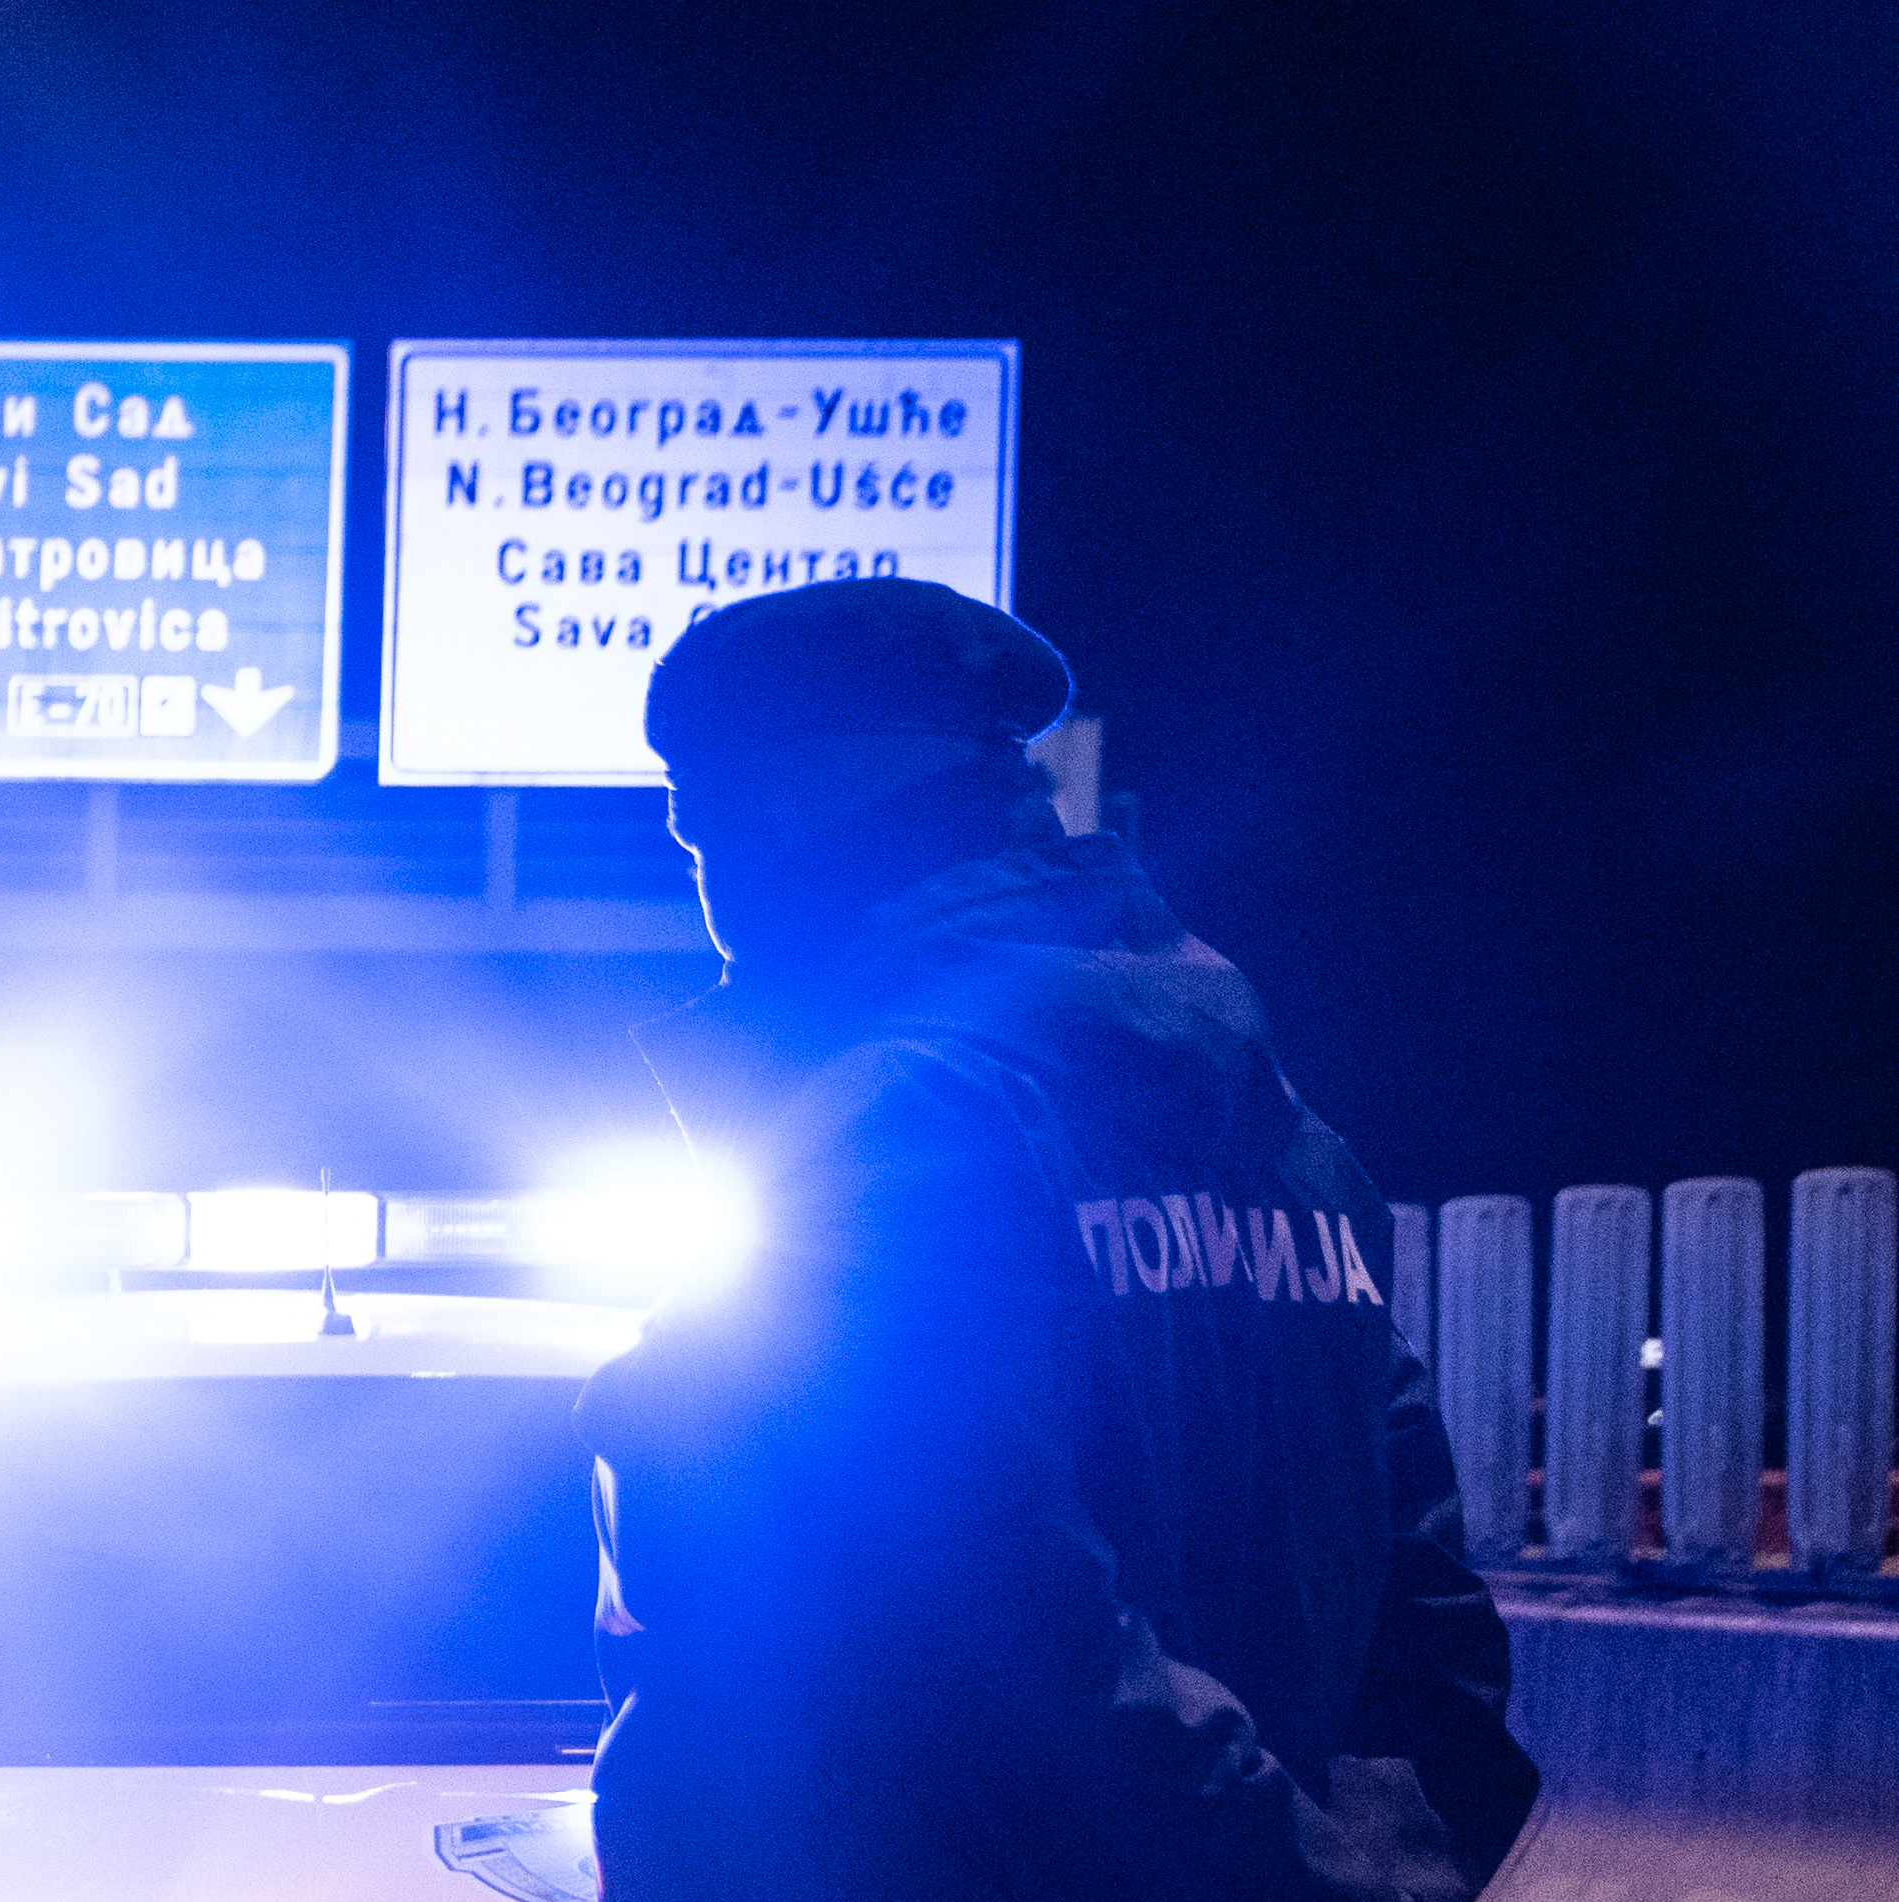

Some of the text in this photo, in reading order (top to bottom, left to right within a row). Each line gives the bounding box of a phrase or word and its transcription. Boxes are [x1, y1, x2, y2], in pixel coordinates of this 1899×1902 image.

[73, 381, 196, 439] Сад
[65, 453, 179, 508] Sad
[495, 538, 643, 587] Сава
[513, 602, 652, 649] Sava
